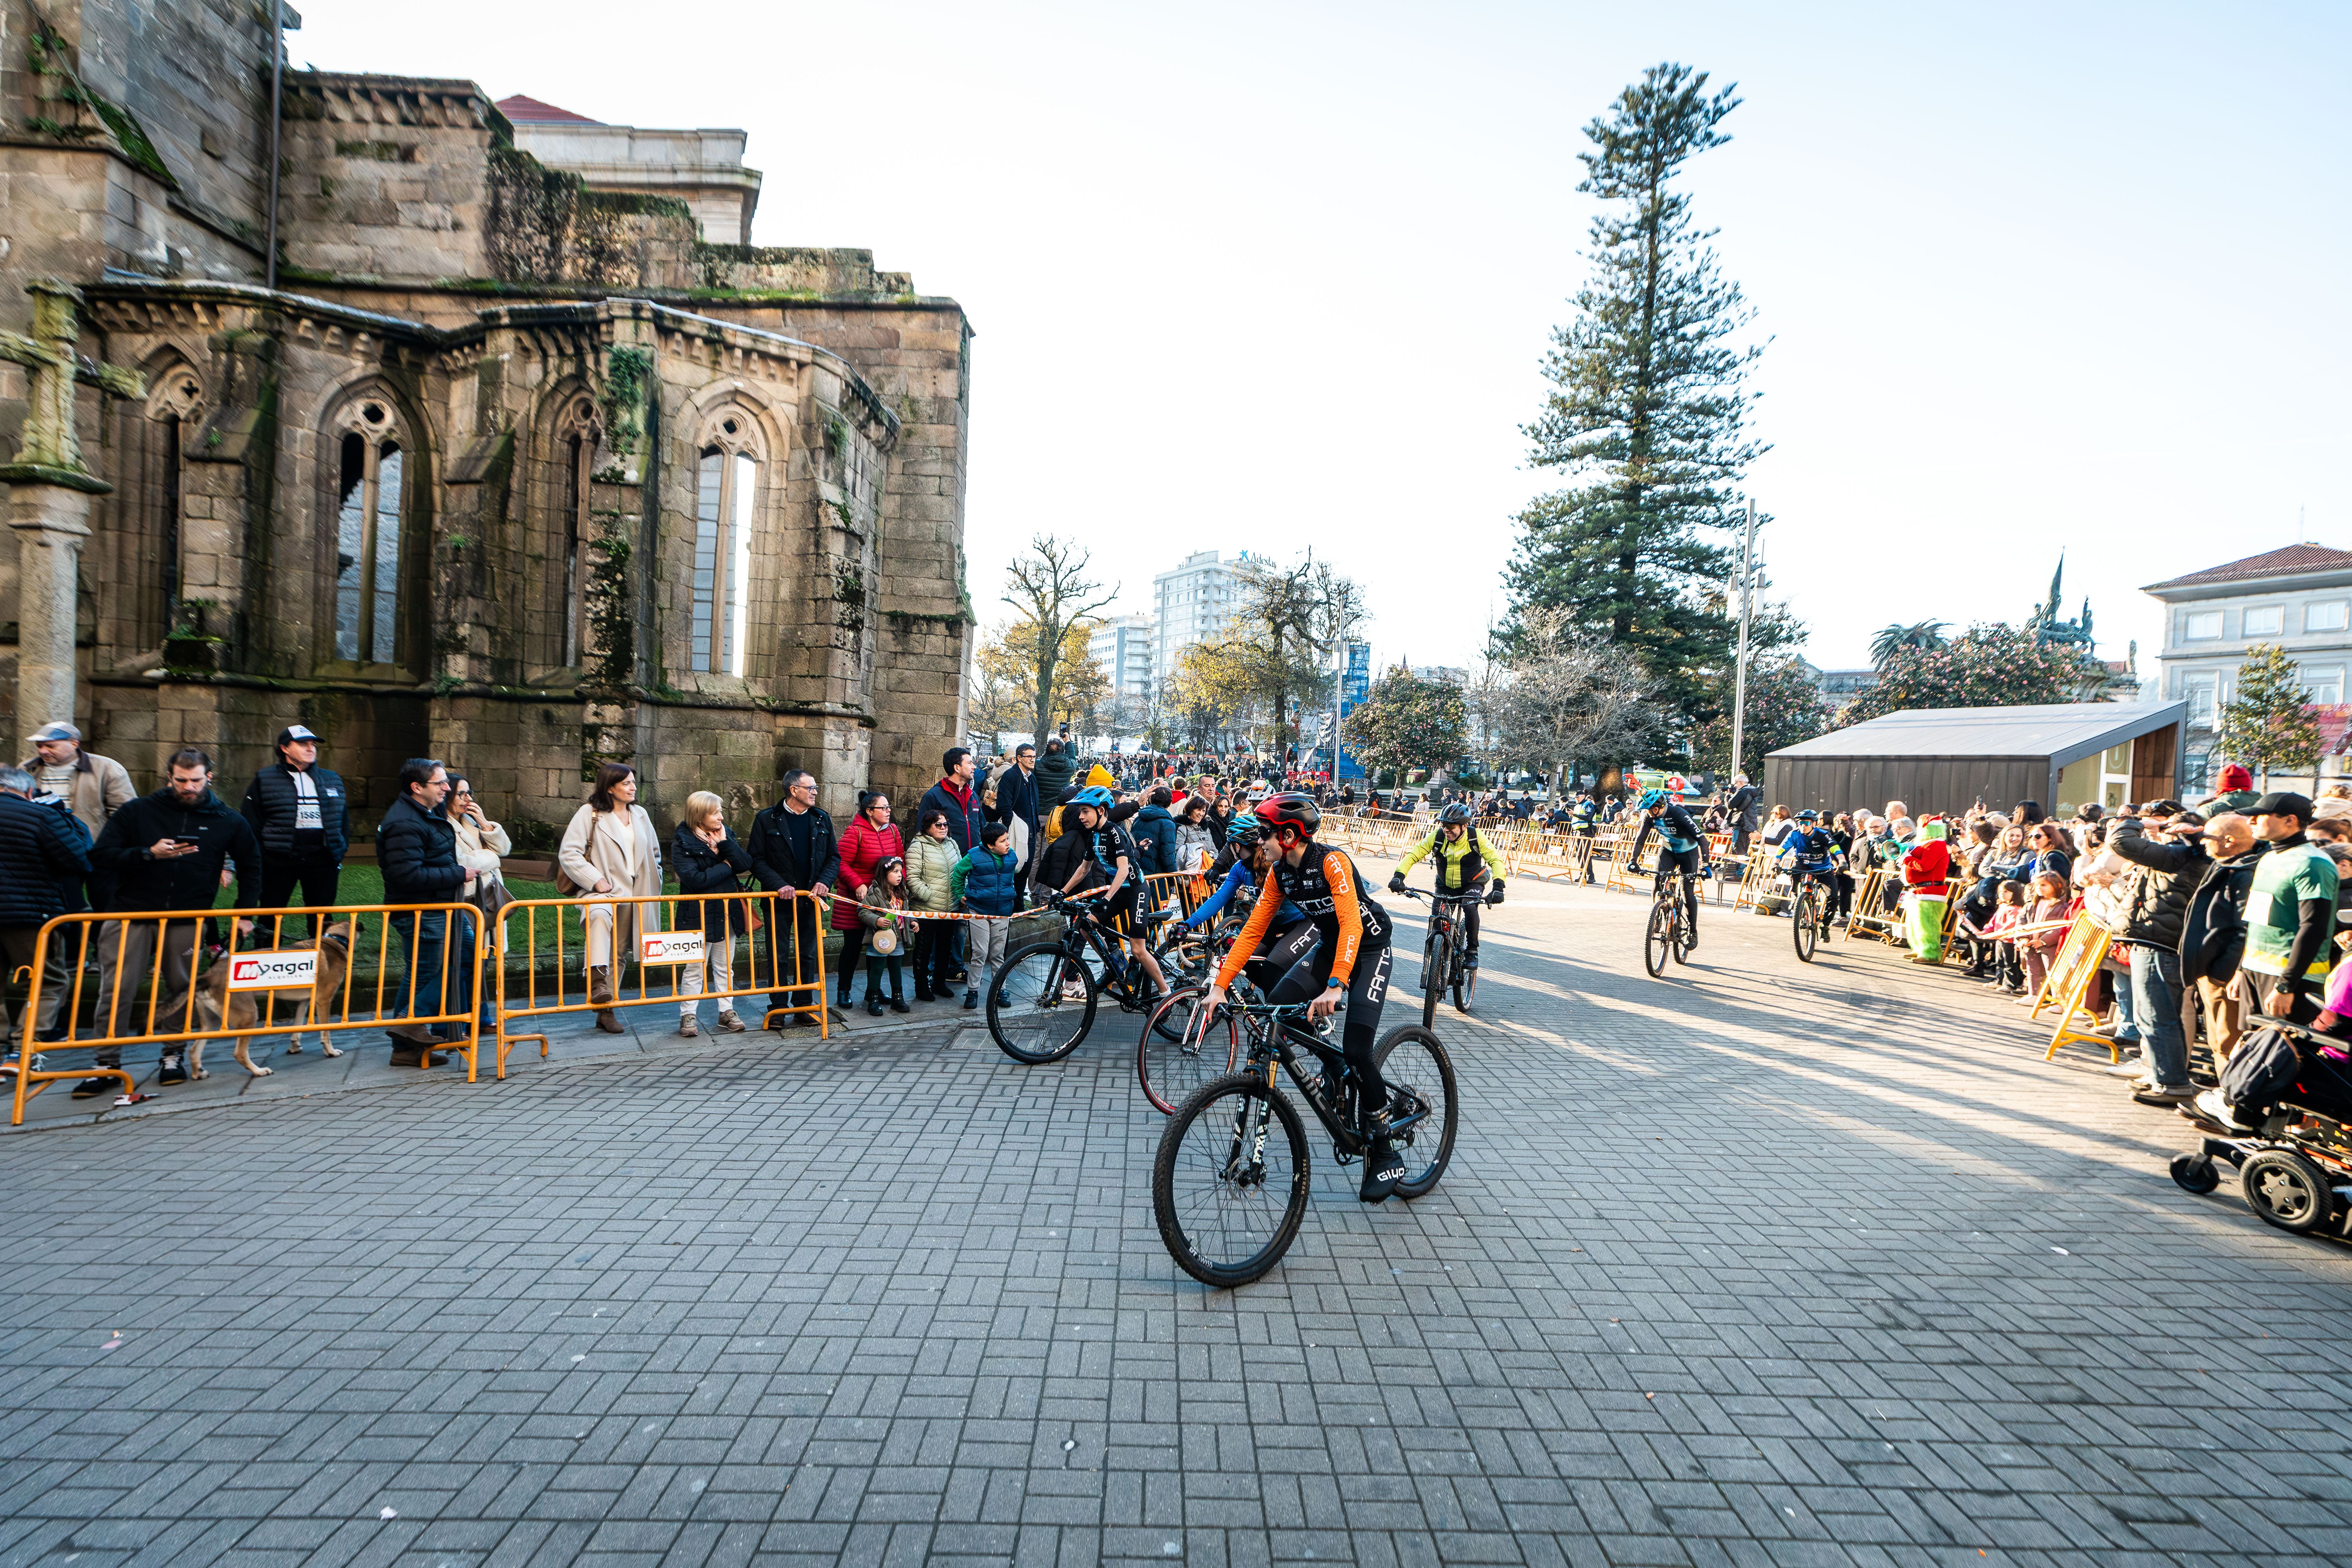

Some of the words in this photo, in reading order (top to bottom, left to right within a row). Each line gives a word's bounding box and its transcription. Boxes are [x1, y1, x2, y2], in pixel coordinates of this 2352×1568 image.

[1326, 854, 1349, 894] FATTO
[1135, 892, 1145, 924] FATTO
[645, 940, 702, 957] Myagal
[1344, 935, 1356, 963] FATTO
[234, 960, 313, 980] Myagal
[1367, 946, 1390, 1004] FATTO
[1189, 1247, 1198, 1257] DT
[1197, 1254, 1213, 1269] SWISS
